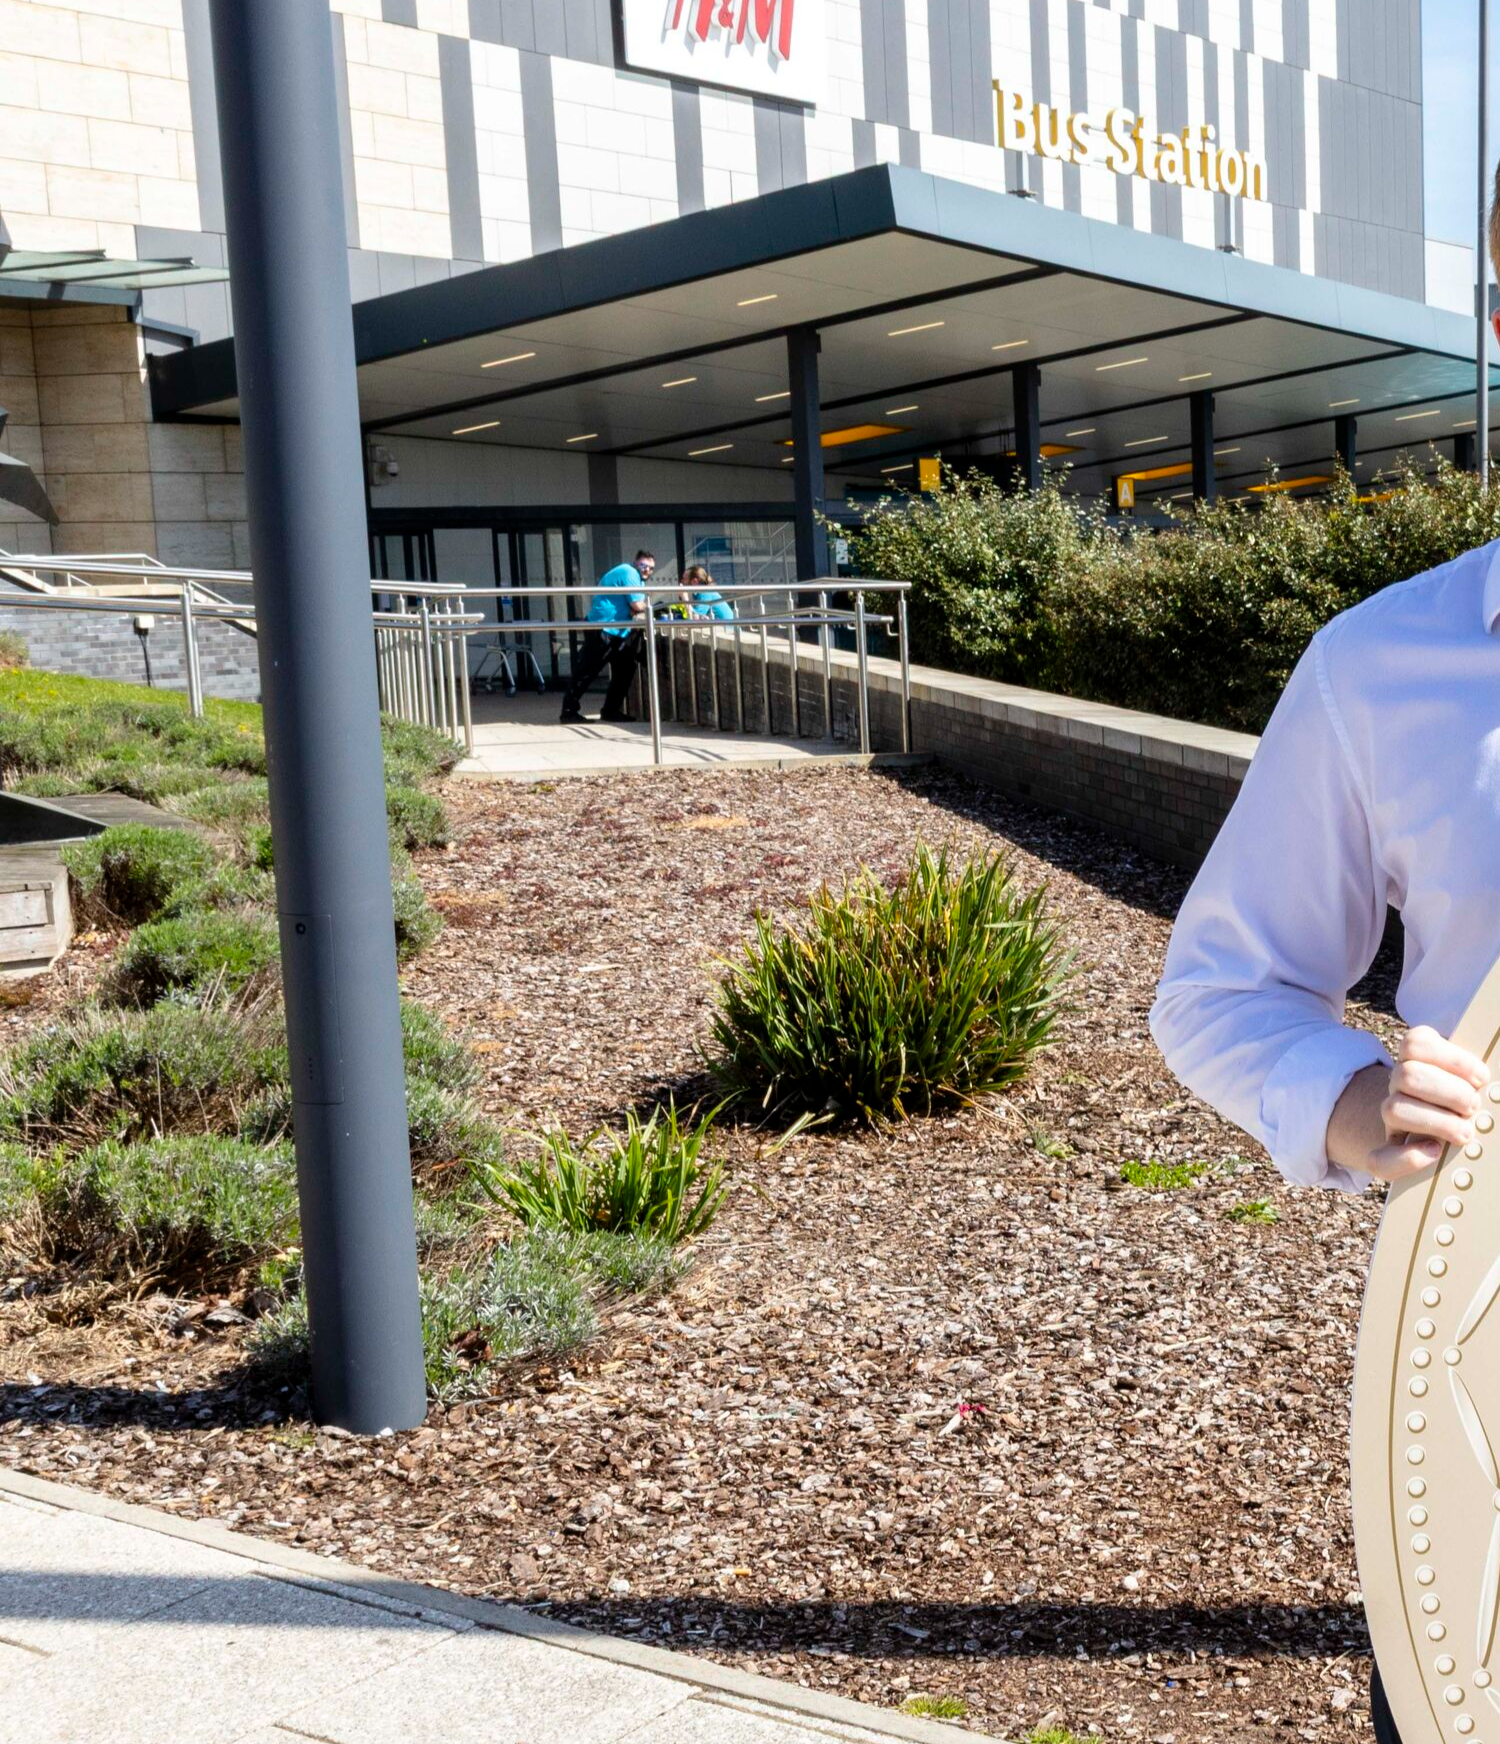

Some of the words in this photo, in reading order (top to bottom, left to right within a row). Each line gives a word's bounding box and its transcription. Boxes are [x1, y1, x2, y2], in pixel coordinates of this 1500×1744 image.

[992, 79, 1094, 165] Bus
[1105, 107, 1267, 202] Station
[1120, 482, 1132, 504] A
